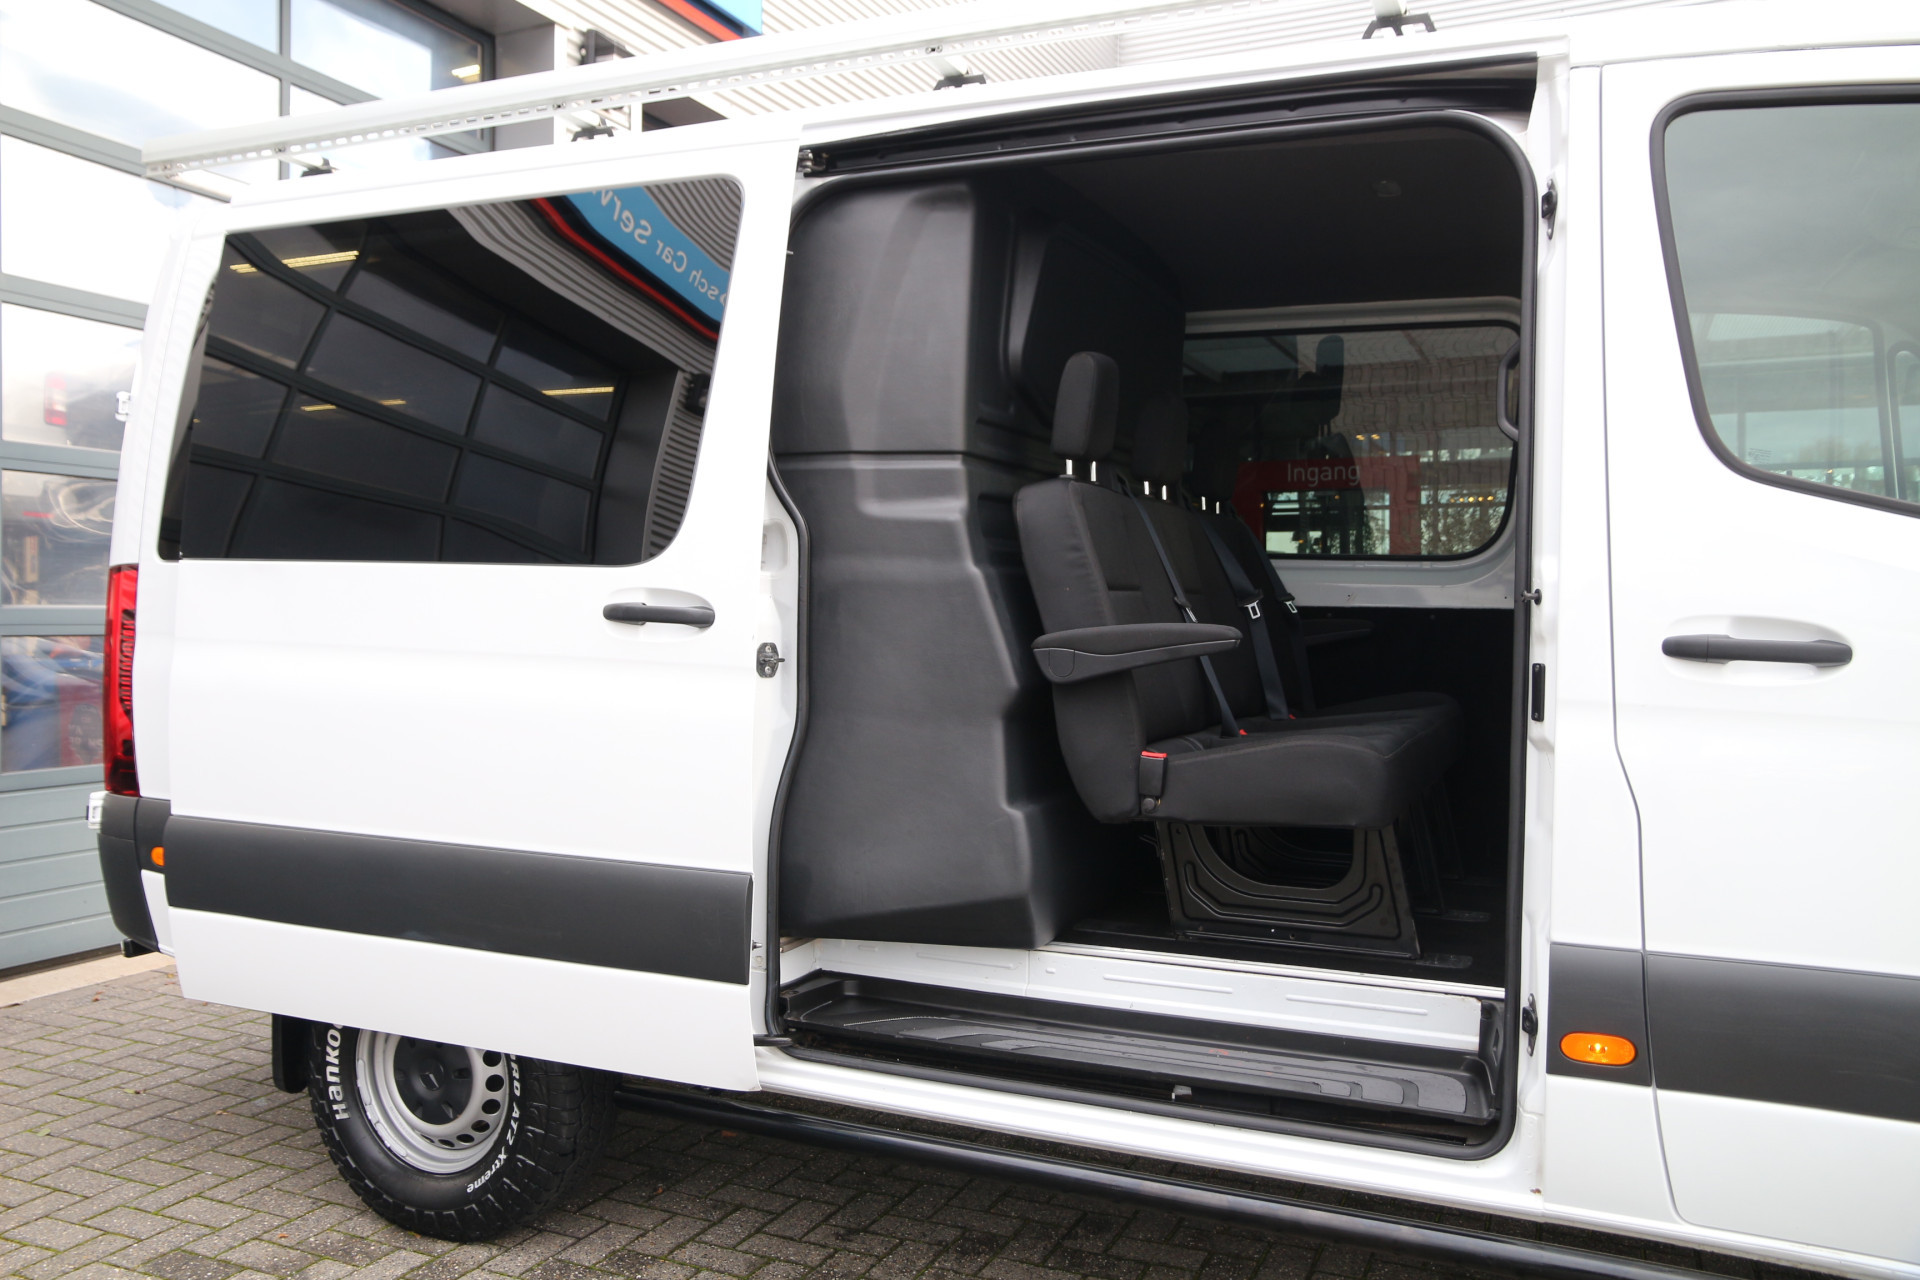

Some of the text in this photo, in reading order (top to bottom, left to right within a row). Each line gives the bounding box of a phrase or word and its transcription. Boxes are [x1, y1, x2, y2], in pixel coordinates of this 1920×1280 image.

[1287, 462, 1360, 487] Ingang
[326, 1024, 350, 1120] Hanko
[507, 1101, 520, 1146] AT2
[467, 1146, 508, 1193] Xtreme
